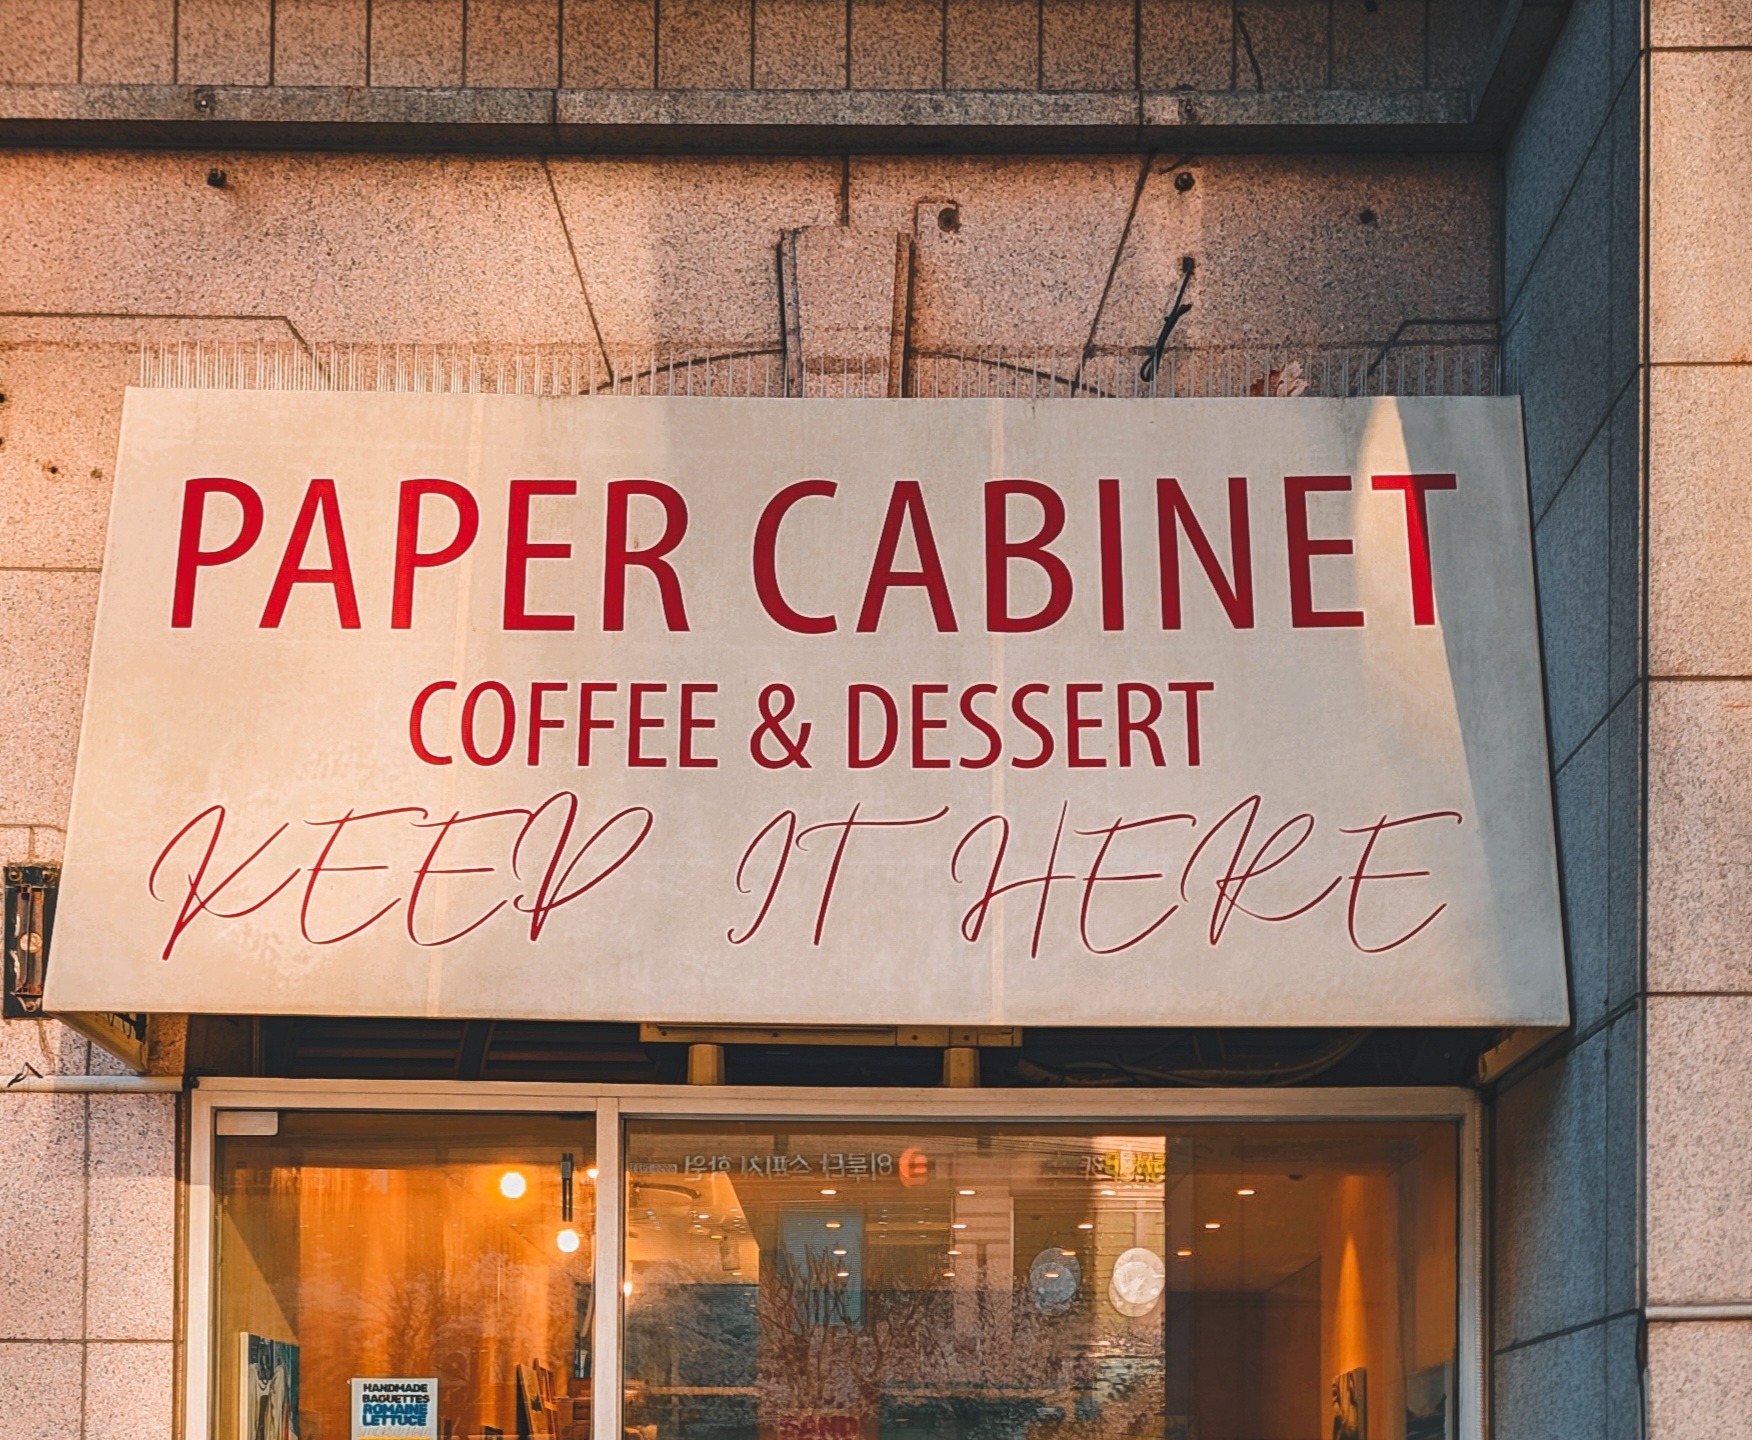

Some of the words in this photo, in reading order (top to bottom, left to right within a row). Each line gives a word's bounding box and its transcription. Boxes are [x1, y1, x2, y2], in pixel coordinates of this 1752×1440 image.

[170, 477, 691, 632] PAPER
[752, 474, 1457, 635] CABINET
[408, 680, 719, 768] COFFEE
[749, 683, 812, 769] &
[847, 682, 1214, 768] DESSERT
[148, 791, 653, 960] KEEP
[727, 801, 949, 945] IT
[951, 795, 1463, 959] HERE
[363, 1383, 428, 1393] HANDMADE
[363, 1403, 428, 1415] ROMAINE
[362, 1415, 427, 1427] LETTUCE
